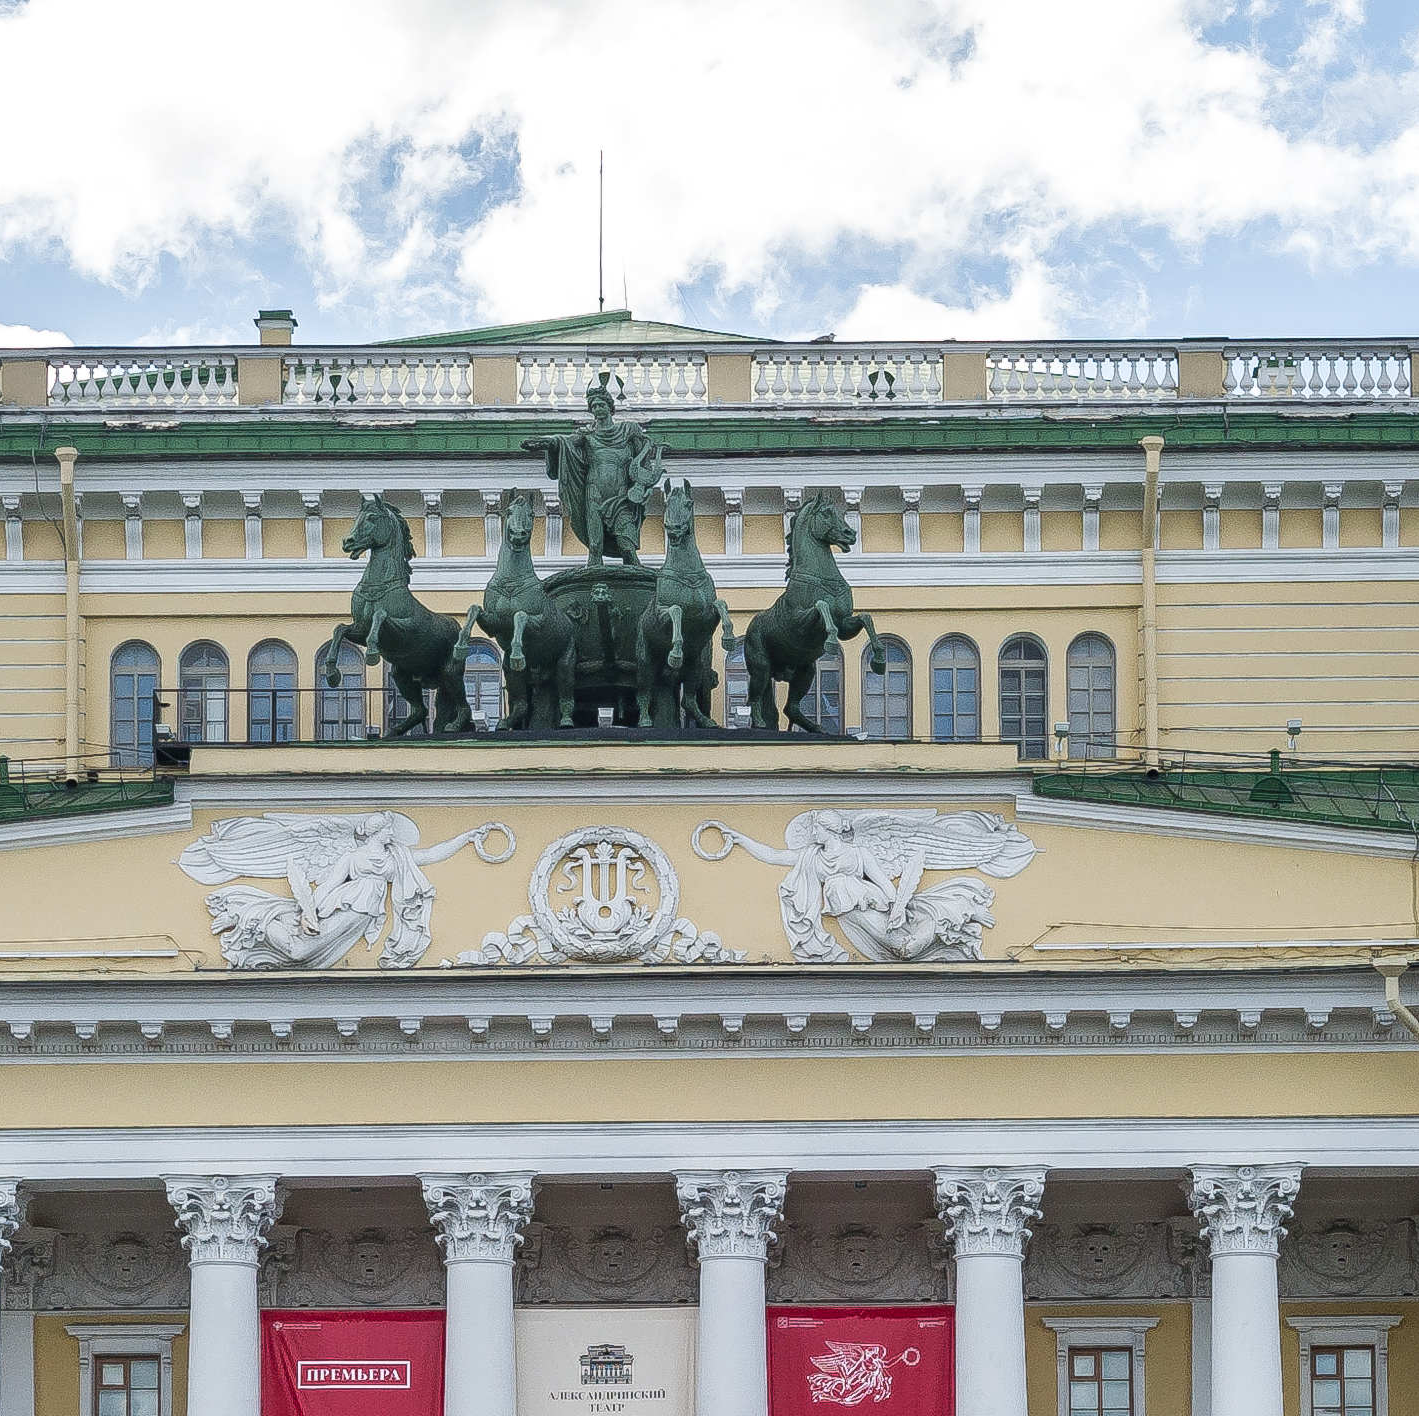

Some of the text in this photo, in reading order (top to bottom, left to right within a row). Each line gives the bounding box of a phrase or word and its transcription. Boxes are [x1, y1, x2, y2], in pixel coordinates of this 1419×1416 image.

[306, 1368, 401, 1382] ПРЕМЬЕРА
[547, 1388, 667, 1401] АЛЕКСАНДРИНСКИЙ
[588, 1403, 626, 1413] ТЕАТР
